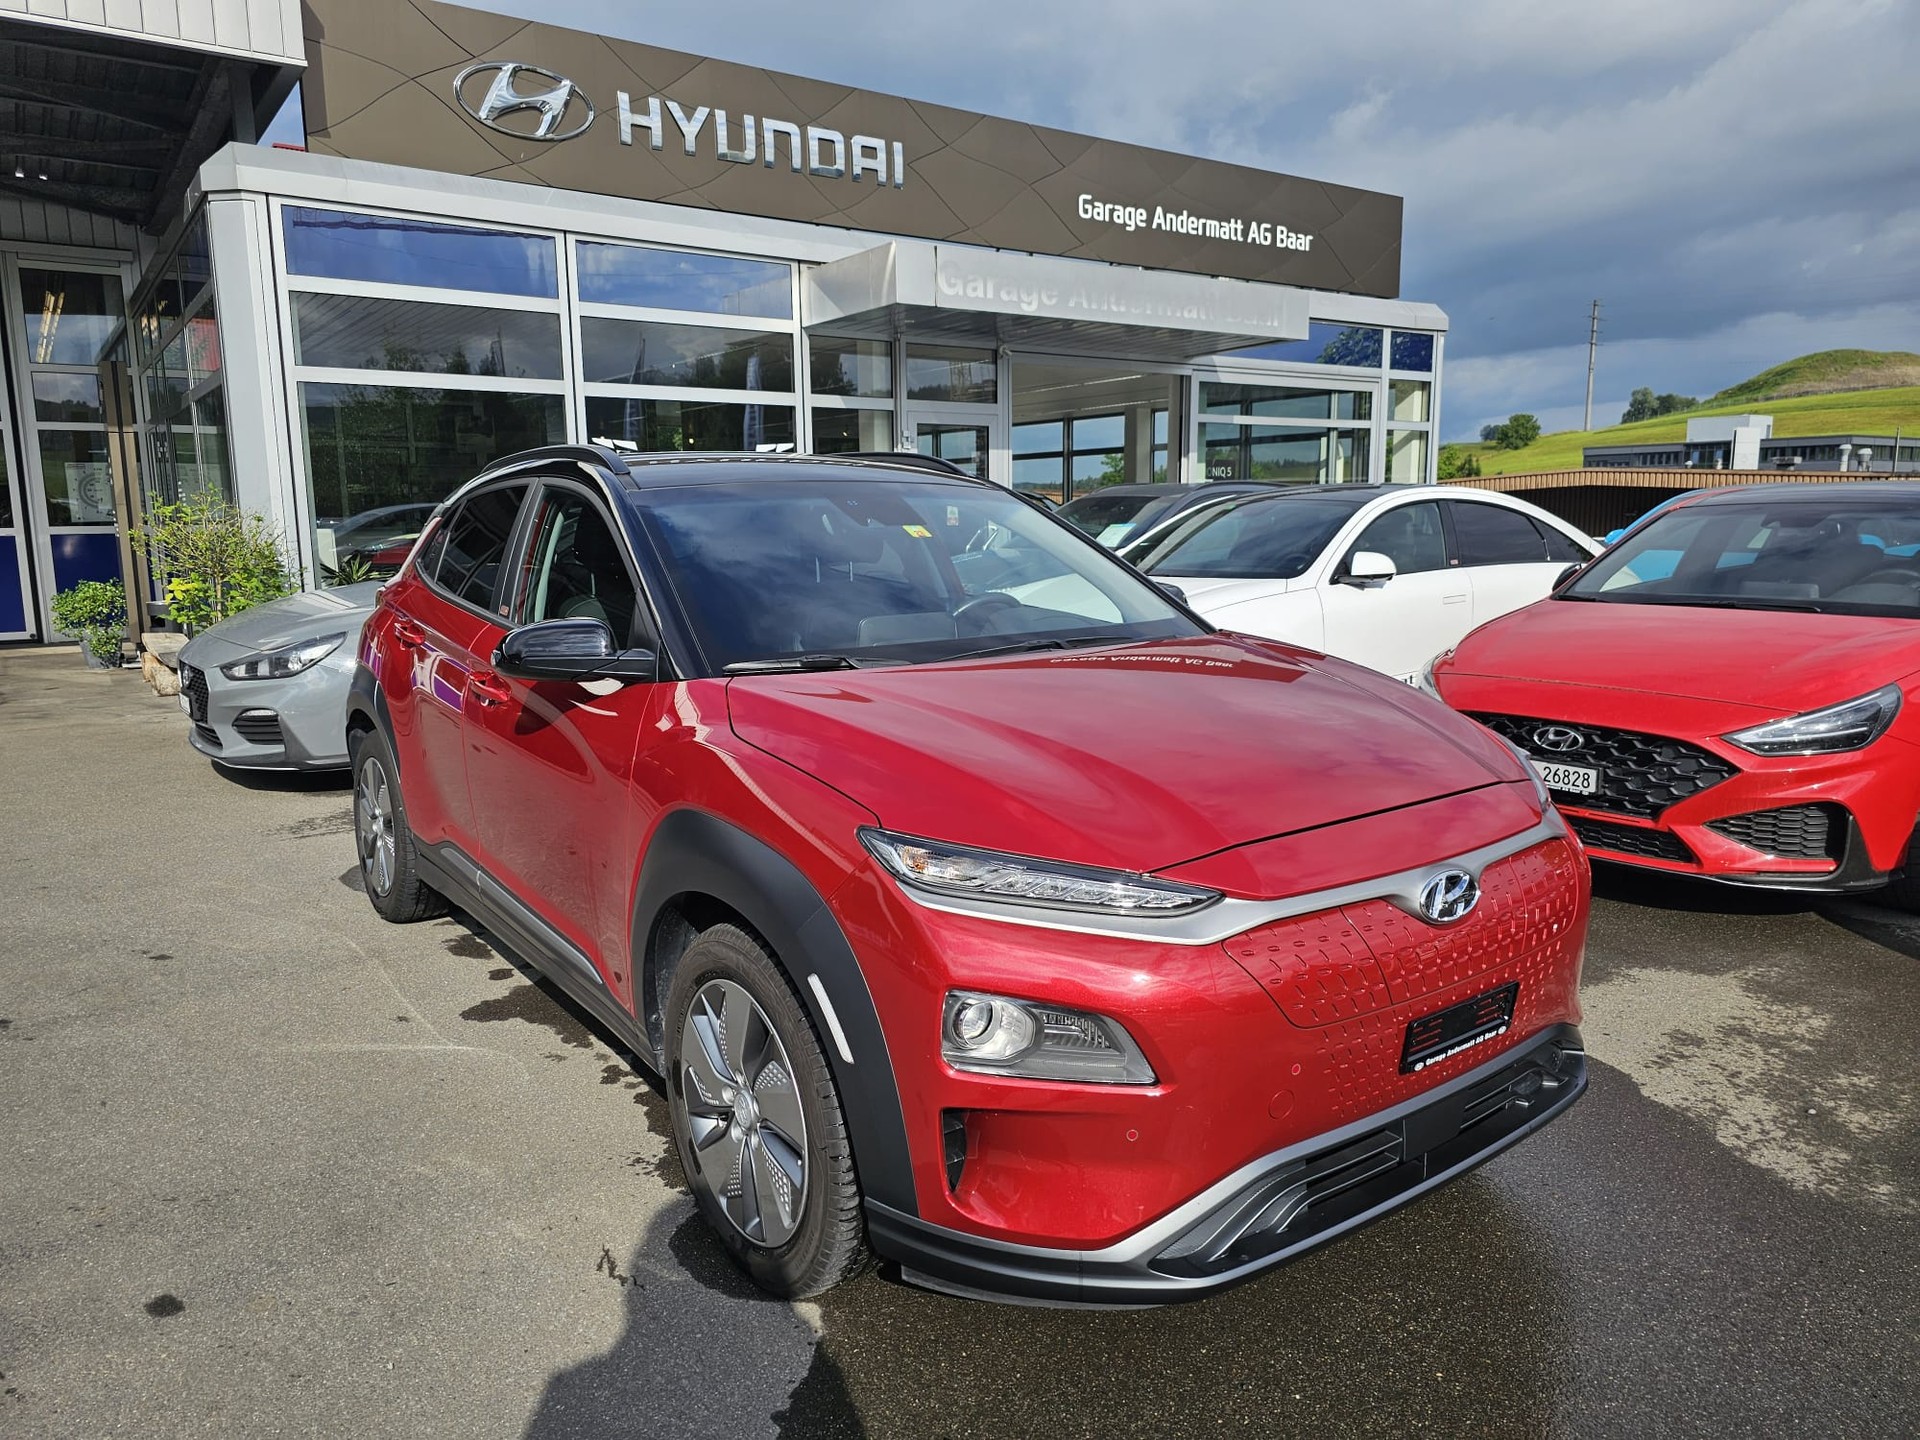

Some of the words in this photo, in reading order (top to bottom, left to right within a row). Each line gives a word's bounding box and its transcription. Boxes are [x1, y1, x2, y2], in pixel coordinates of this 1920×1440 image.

[617, 90, 904, 188] HYUNDAI
[1078, 194, 1147, 231] Garage
[1152, 205, 1244, 241] Andermatt
[1247, 221, 1271, 246] AG
[1276, 226, 1314, 252] Baar
[937, 260, 1059, 312] Garage
[1227, 467, 1232, 476] 5
[1543, 766, 1591, 789] 26828
